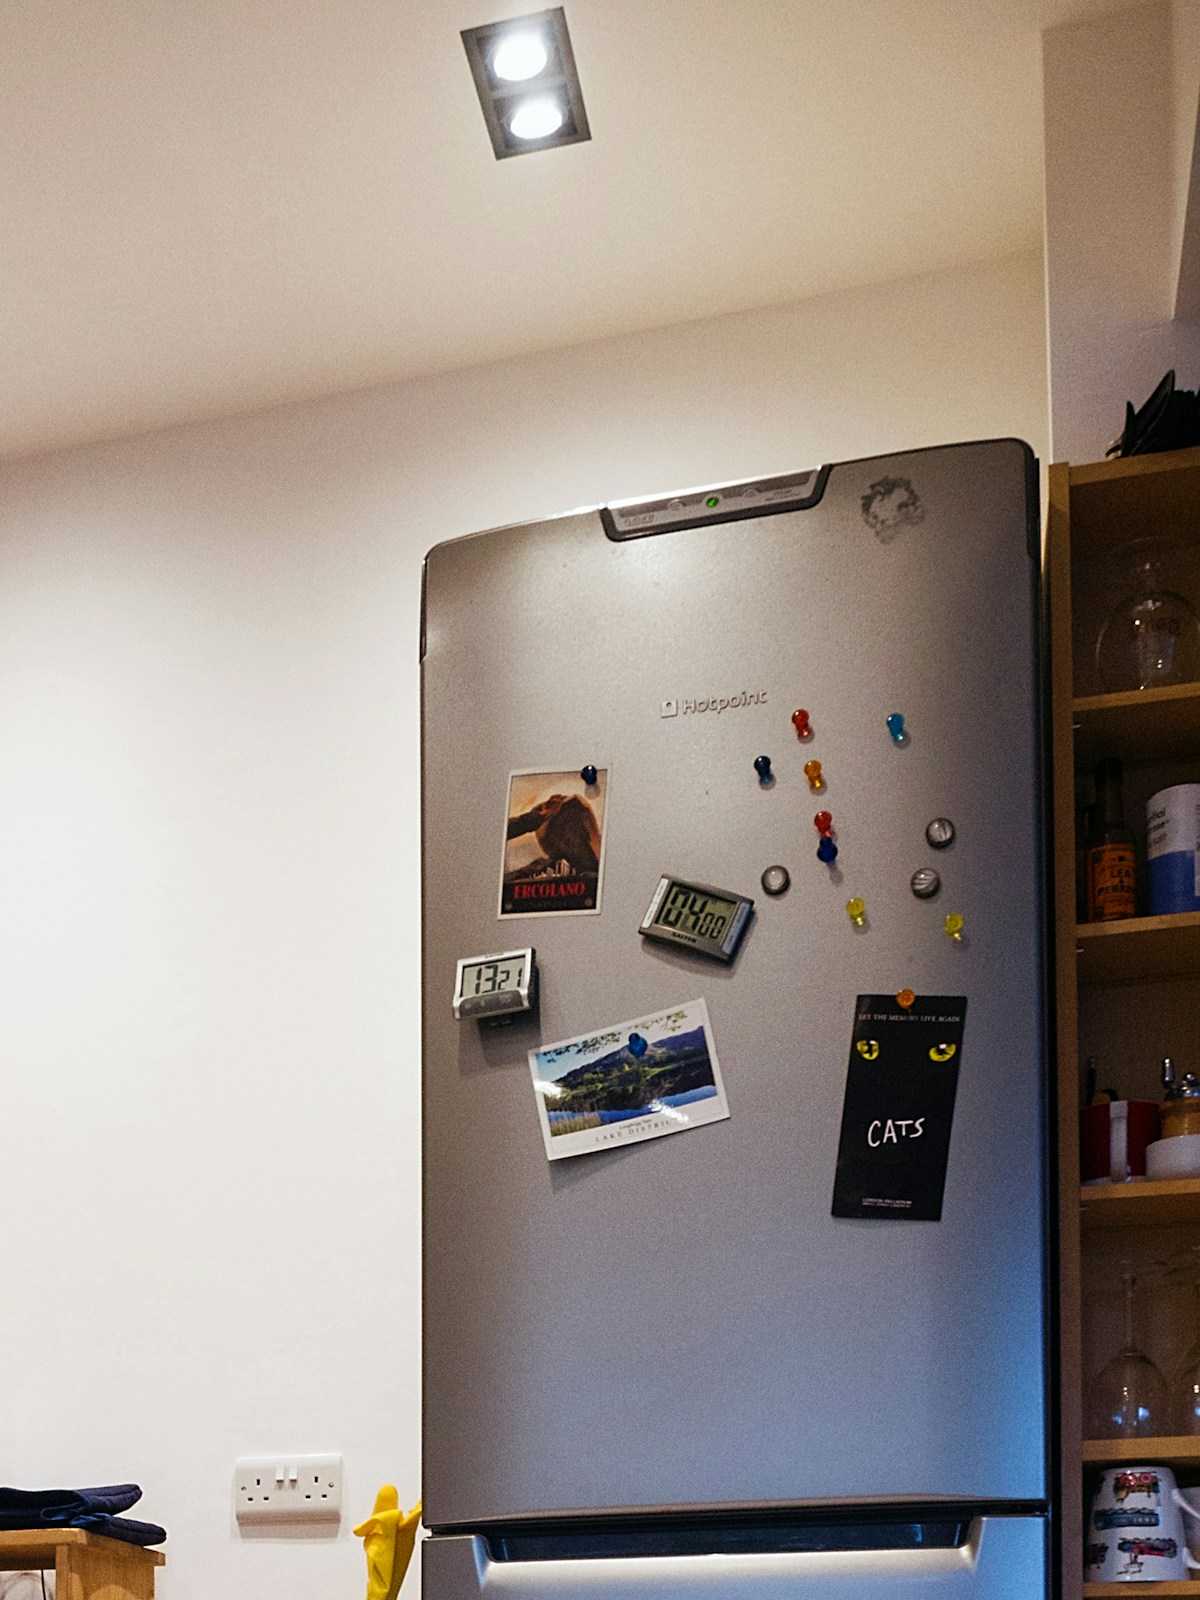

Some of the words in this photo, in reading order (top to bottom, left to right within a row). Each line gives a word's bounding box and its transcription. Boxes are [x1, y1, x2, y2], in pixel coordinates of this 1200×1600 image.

[683, 690, 767, 714] Hotpoint
[513, 882, 586, 899] ERCOLANO
[938, 1015, 960, 1023] AGAIN
[596, 1131, 623, 1143] LAKE
[867, 1117, 925, 1148] CATS
